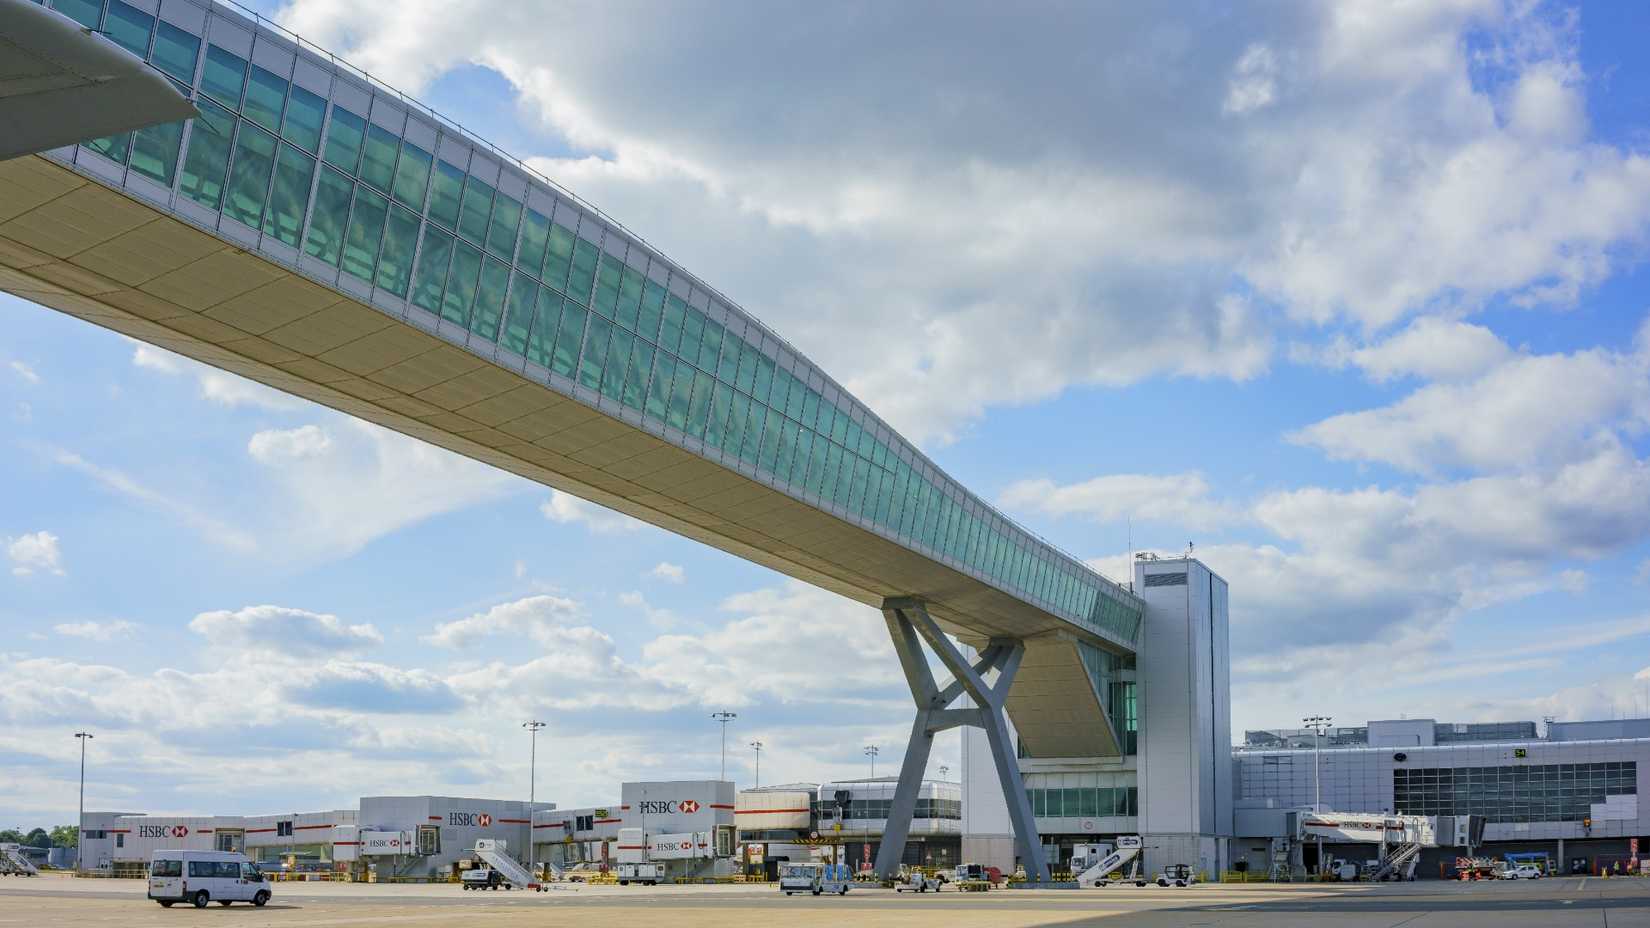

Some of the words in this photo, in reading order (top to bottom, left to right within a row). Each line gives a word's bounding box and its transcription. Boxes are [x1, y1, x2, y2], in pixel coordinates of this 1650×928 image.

[639, 800, 677, 814] HSBC
[449, 812, 477, 826] HSBC
[139, 825, 170, 838] HSBC
[656, 842, 680, 850] HSBC
